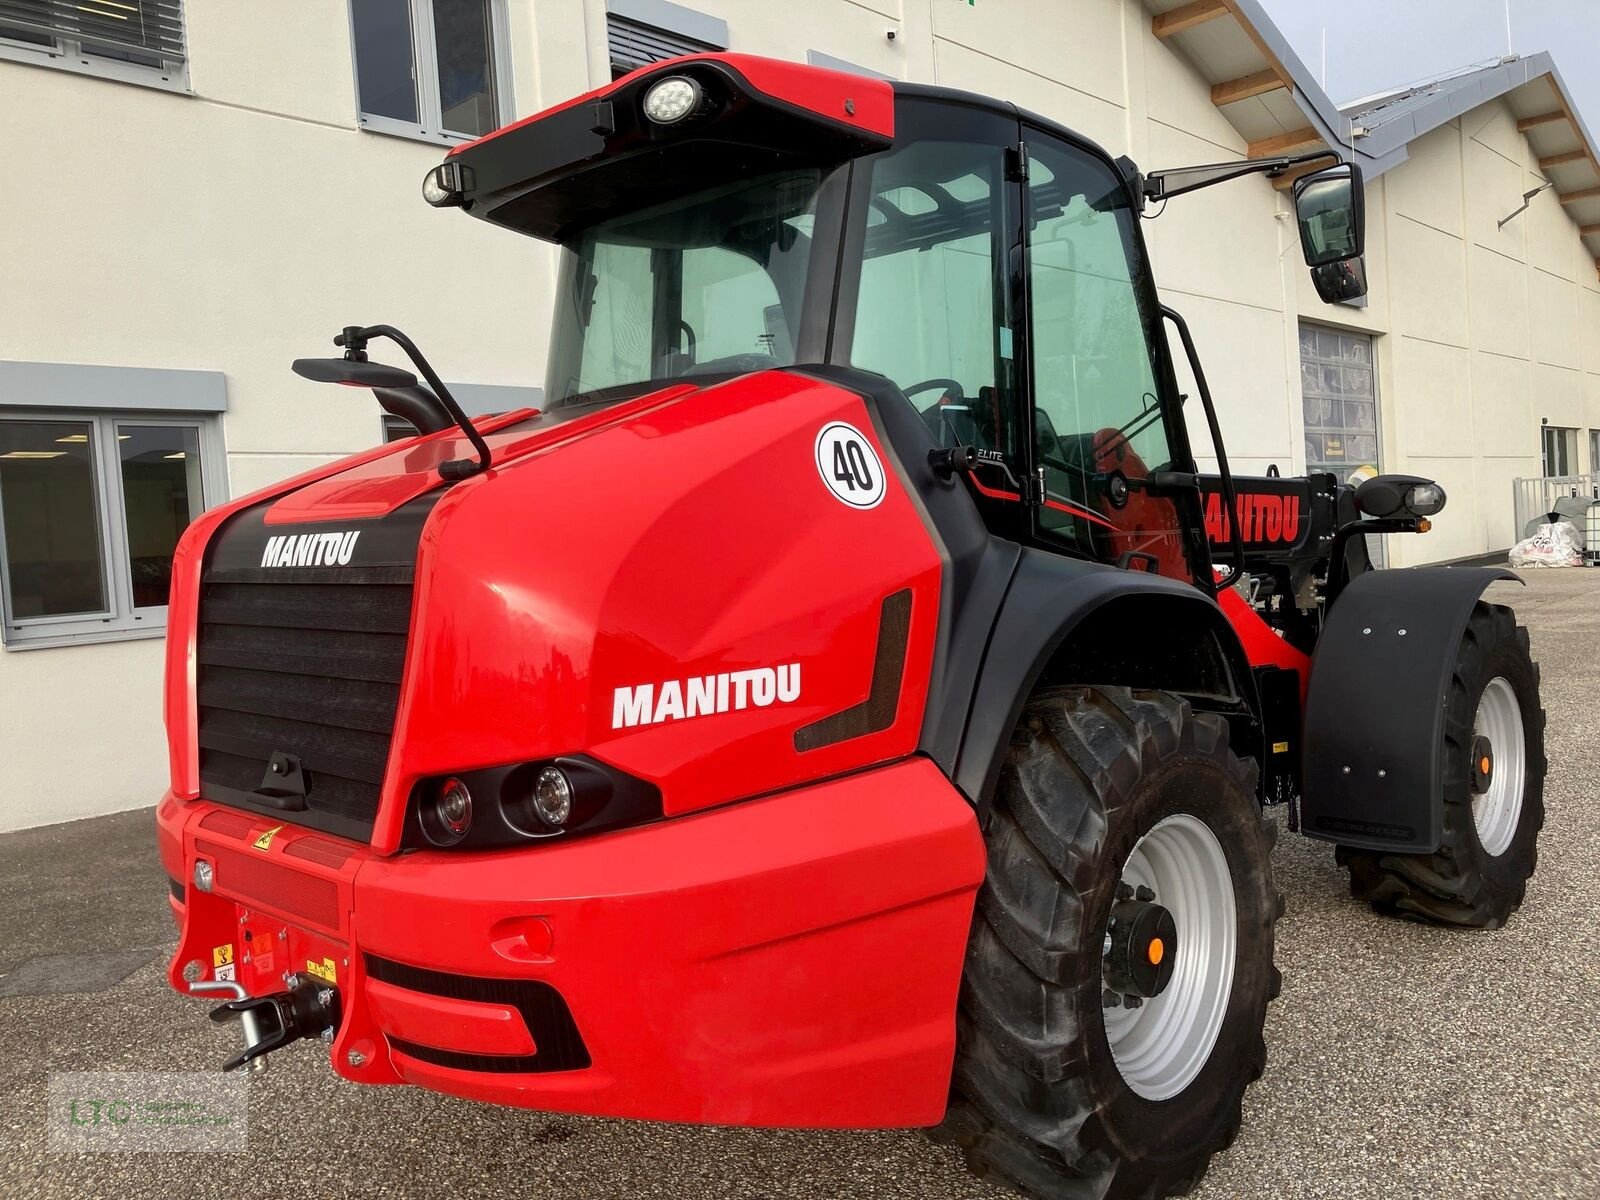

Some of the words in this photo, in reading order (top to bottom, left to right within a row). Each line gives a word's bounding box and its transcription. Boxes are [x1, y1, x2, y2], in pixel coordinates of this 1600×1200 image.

[833, 440, 874, 491] 40
[977, 448, 1003, 461] ELITE
[1199, 492, 1300, 543] ANITOU
[260, 530, 361, 568] MANITOU
[612, 663, 801, 729] MANITOU
